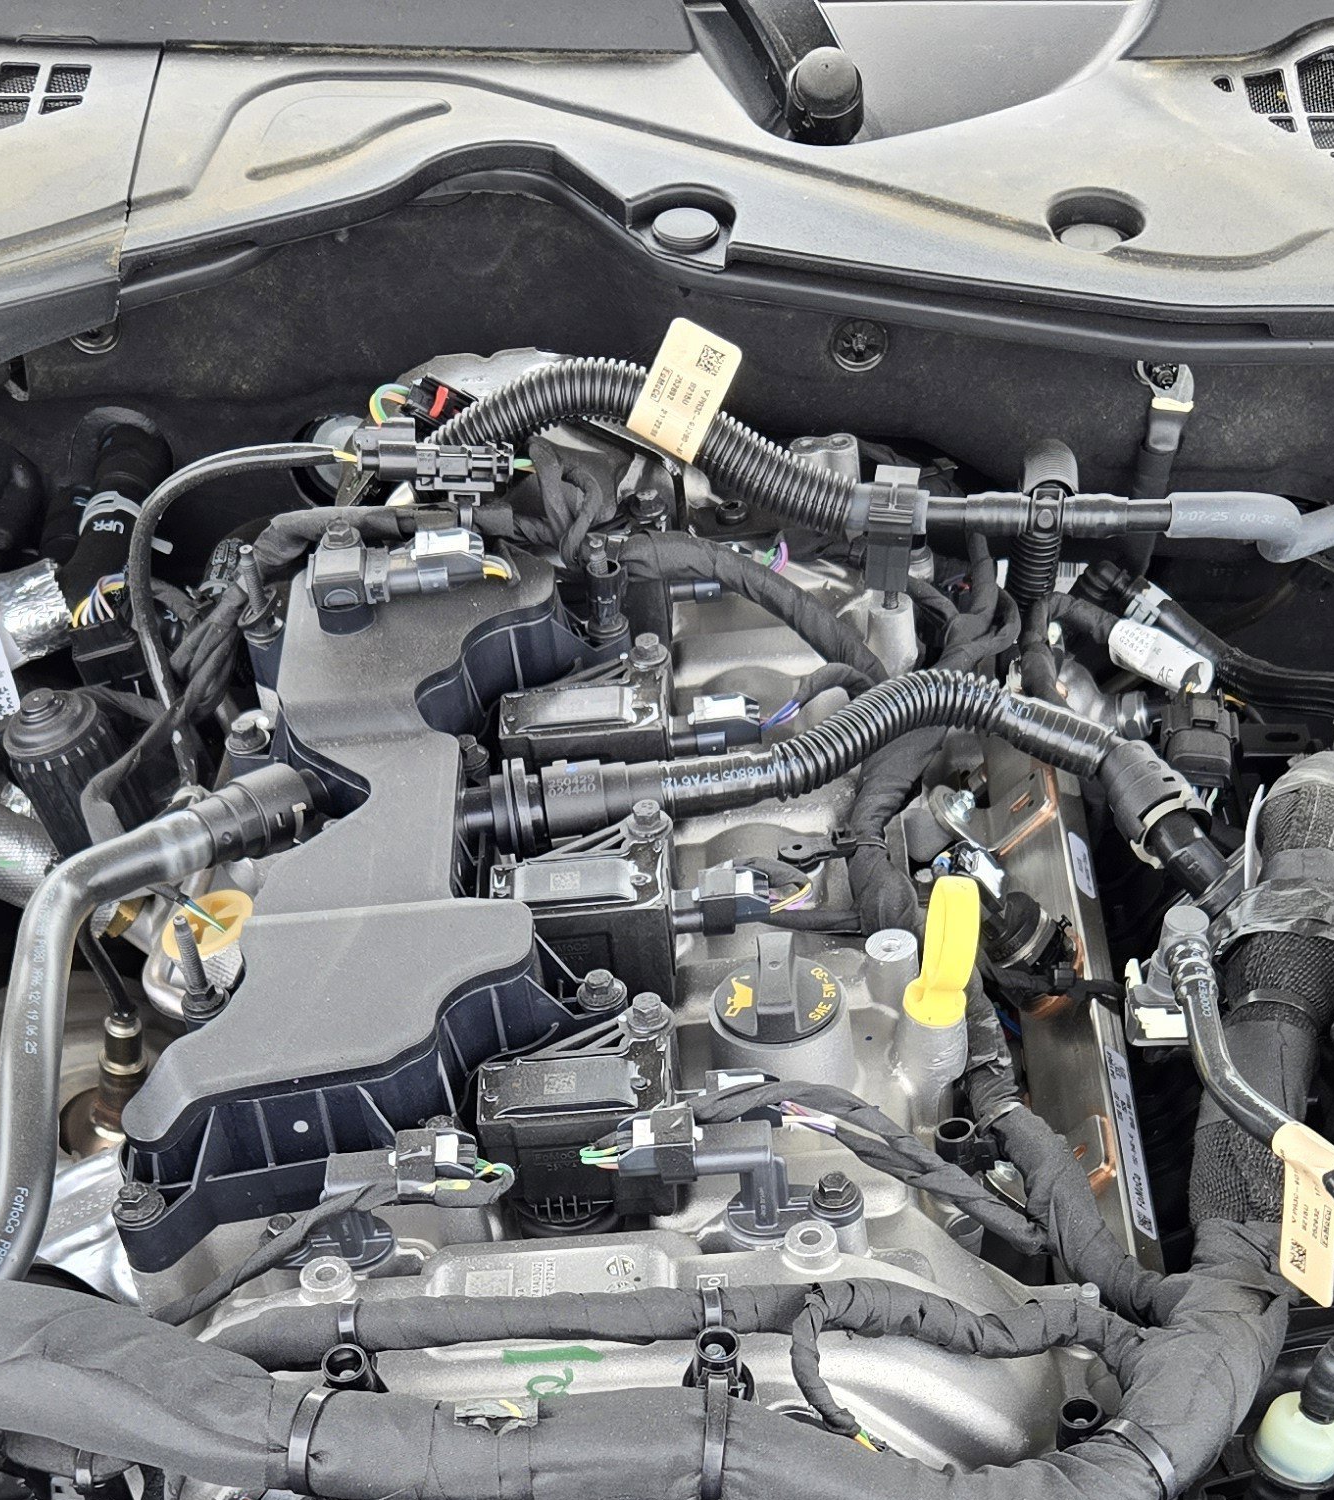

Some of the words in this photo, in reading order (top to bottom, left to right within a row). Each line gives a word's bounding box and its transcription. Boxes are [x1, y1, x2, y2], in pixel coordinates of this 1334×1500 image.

[92, 520, 125, 535] UPR
[808, 1001, 833, 1021] SAE
[4, 1186, 29, 1235] FoMoCo
